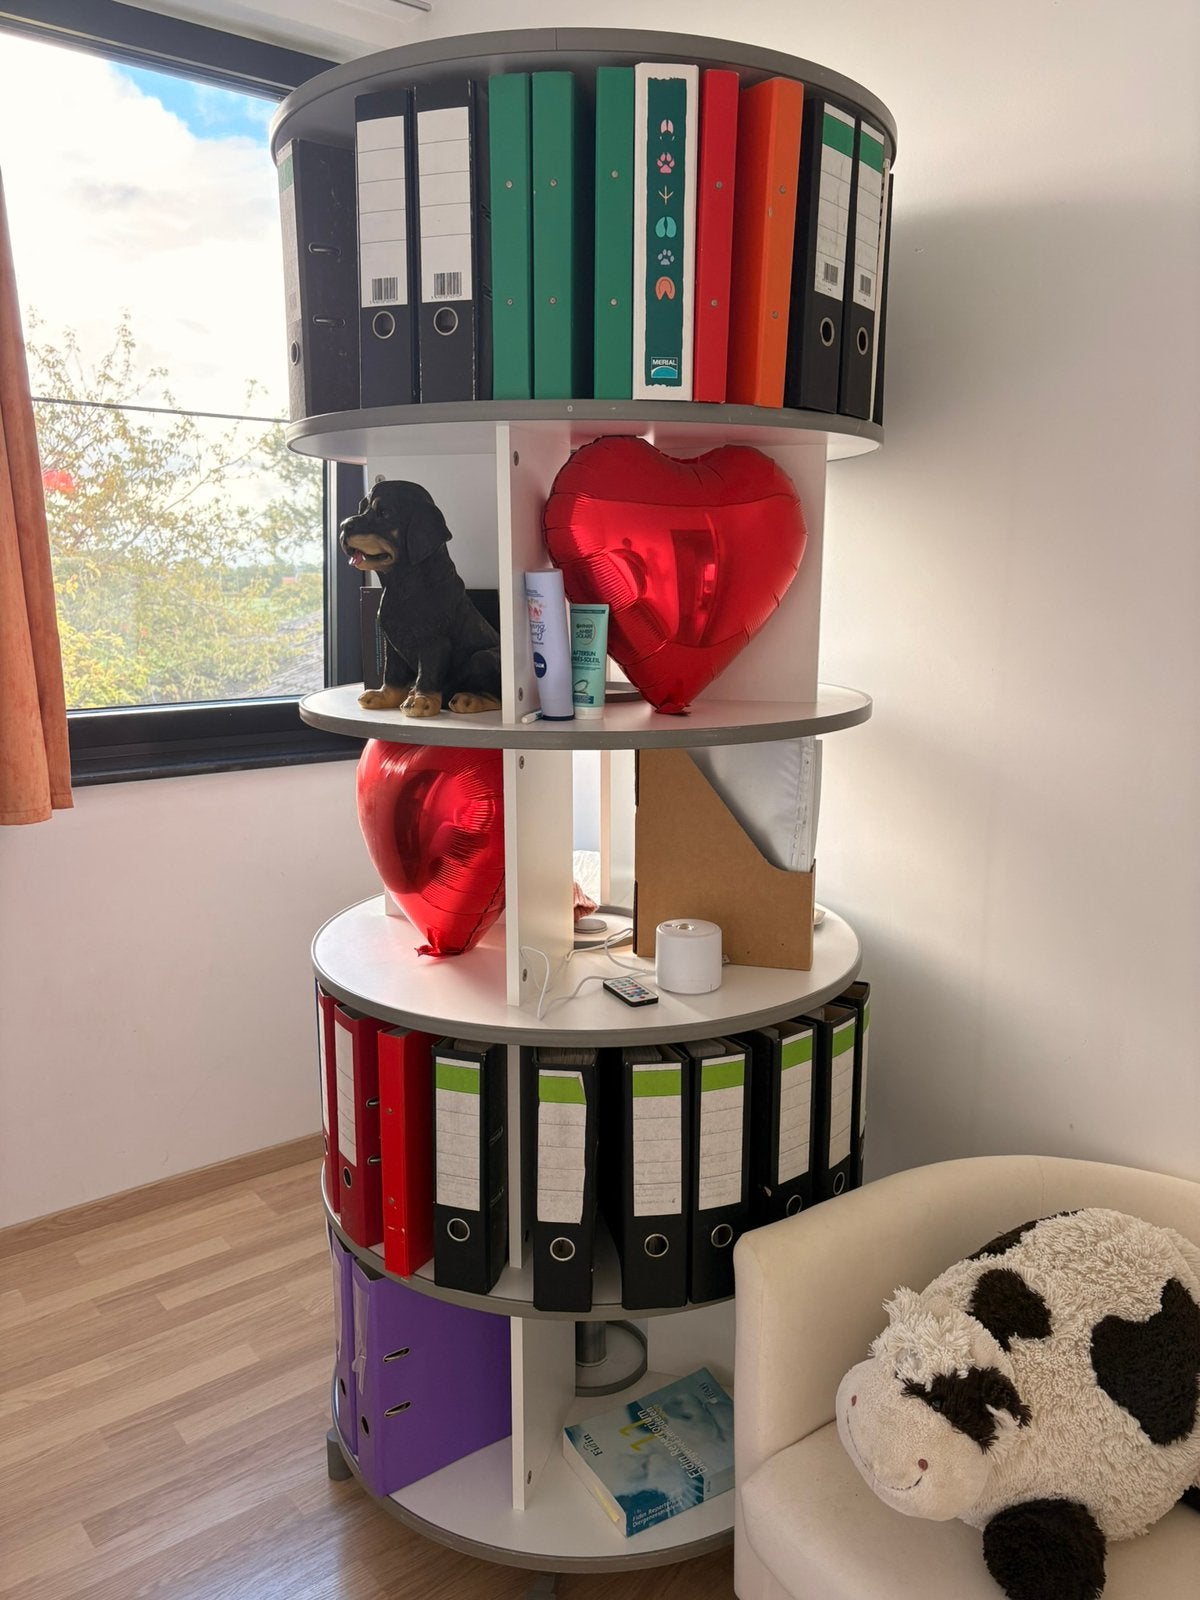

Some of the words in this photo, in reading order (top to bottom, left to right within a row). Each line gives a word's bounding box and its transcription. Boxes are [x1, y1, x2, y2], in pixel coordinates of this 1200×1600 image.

[583, 1433, 603, 1457] Fidin
[637, 1409, 681, 1457] Repertorium
[679, 1452, 703, 1479] Fidin
